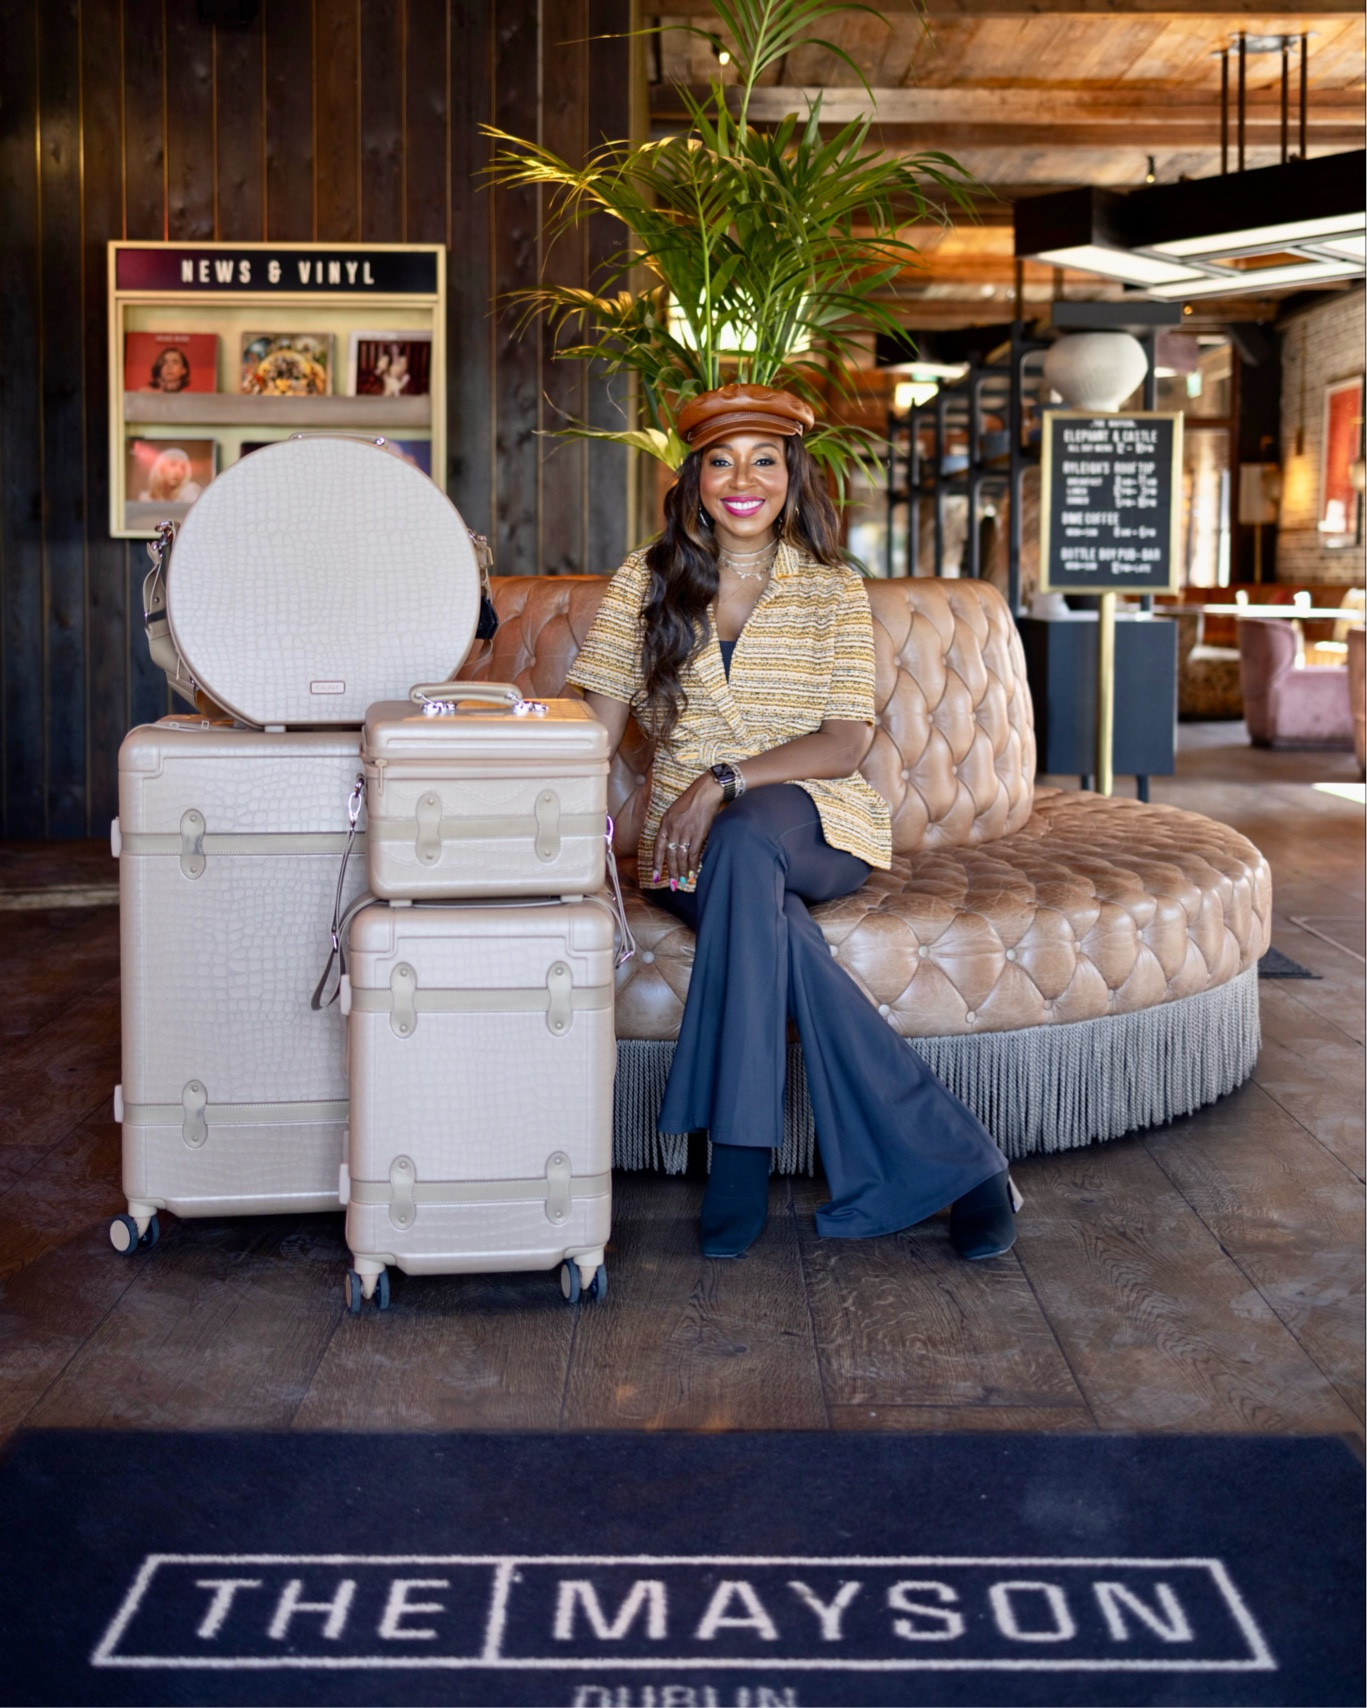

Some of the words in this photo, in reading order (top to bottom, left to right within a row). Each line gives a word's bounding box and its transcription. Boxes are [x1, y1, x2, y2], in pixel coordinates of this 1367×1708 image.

[181, 259, 251, 283] NEWS
[268, 259, 282, 284] &
[298, 260, 375, 285] VINYL
[1063, 429, 1109, 443] ELEPHANT
[1122, 429, 1158, 443] CASTLE
[1084, 511, 1120, 525] COFFEE
[1060, 546, 1096, 561] BOTTLE
[195, 1578, 450, 1639] THE
[552, 1579, 1195, 1643] MAYSON
